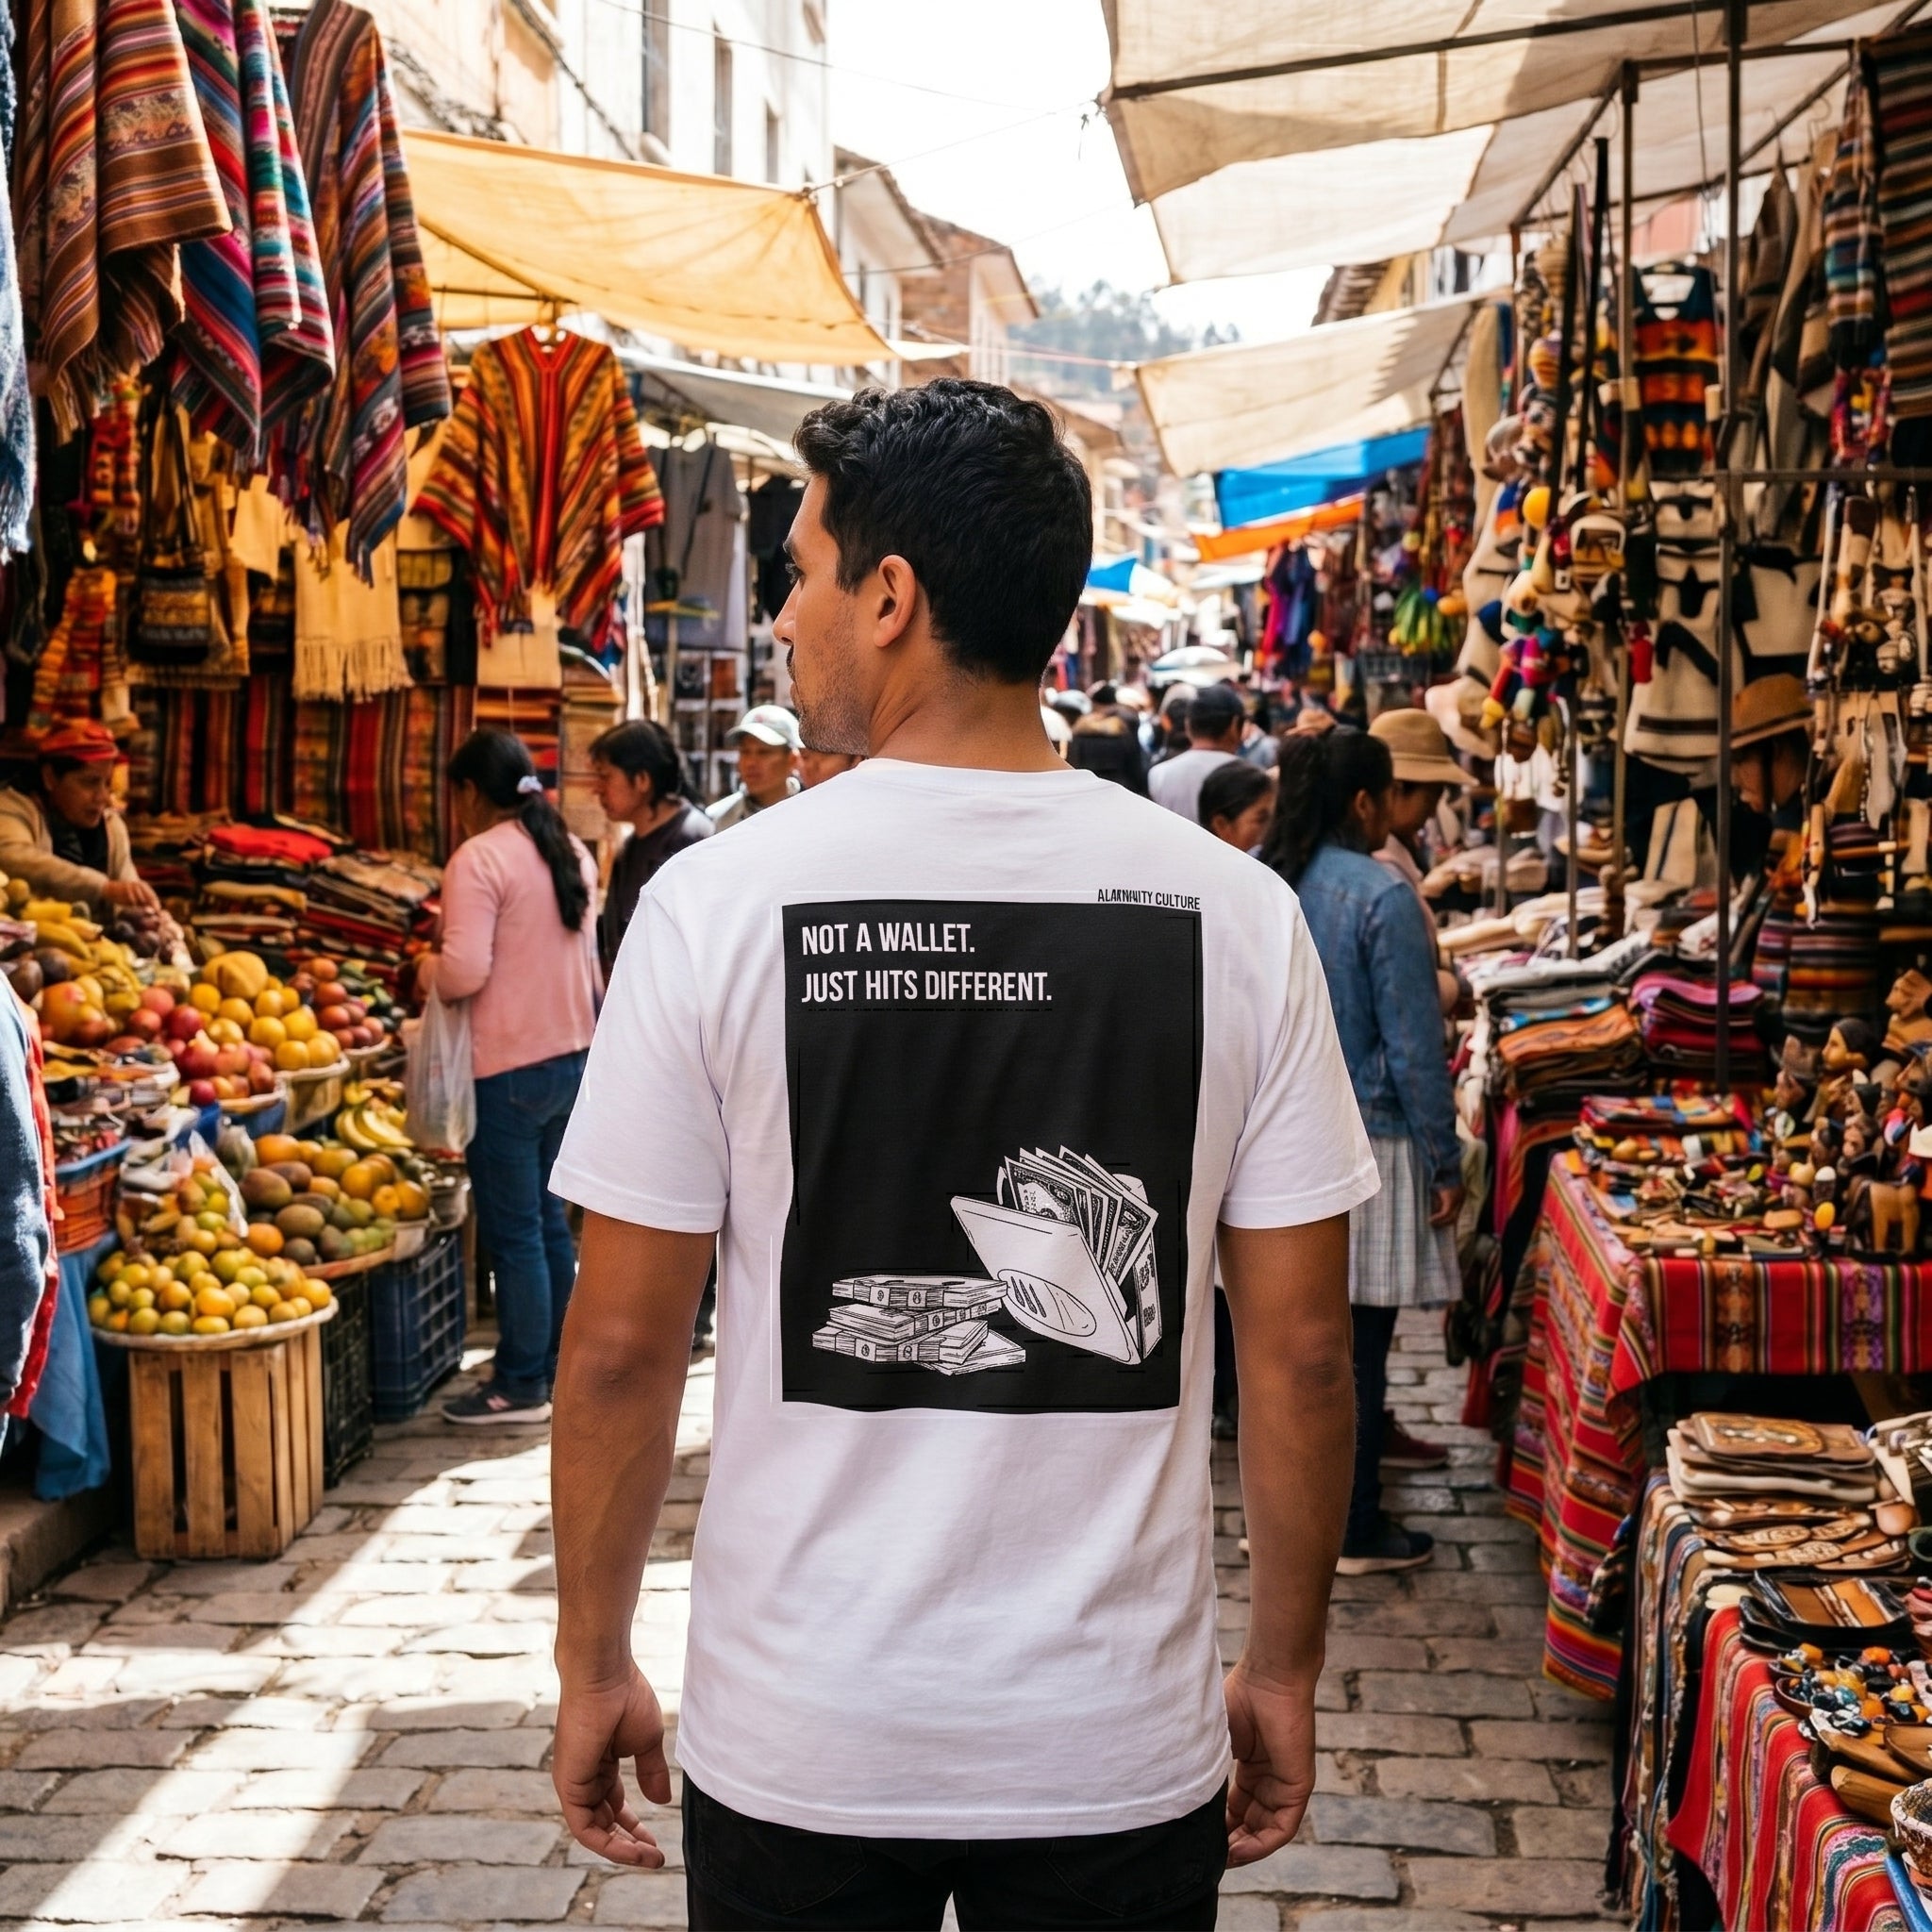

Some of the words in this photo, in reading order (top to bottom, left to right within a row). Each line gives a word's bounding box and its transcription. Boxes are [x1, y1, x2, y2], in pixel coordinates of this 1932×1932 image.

[1156, 892, 1200, 910] CULTURE
[802, 924, 849, 956] NOT
[856, 923, 873, 953] A
[877, 922, 975, 953] WALLET.
[801, 970, 858, 1003] JUST
[865, 970, 918, 1000] HITS
[924, 970, 1052, 1001] DIFFERENT.
